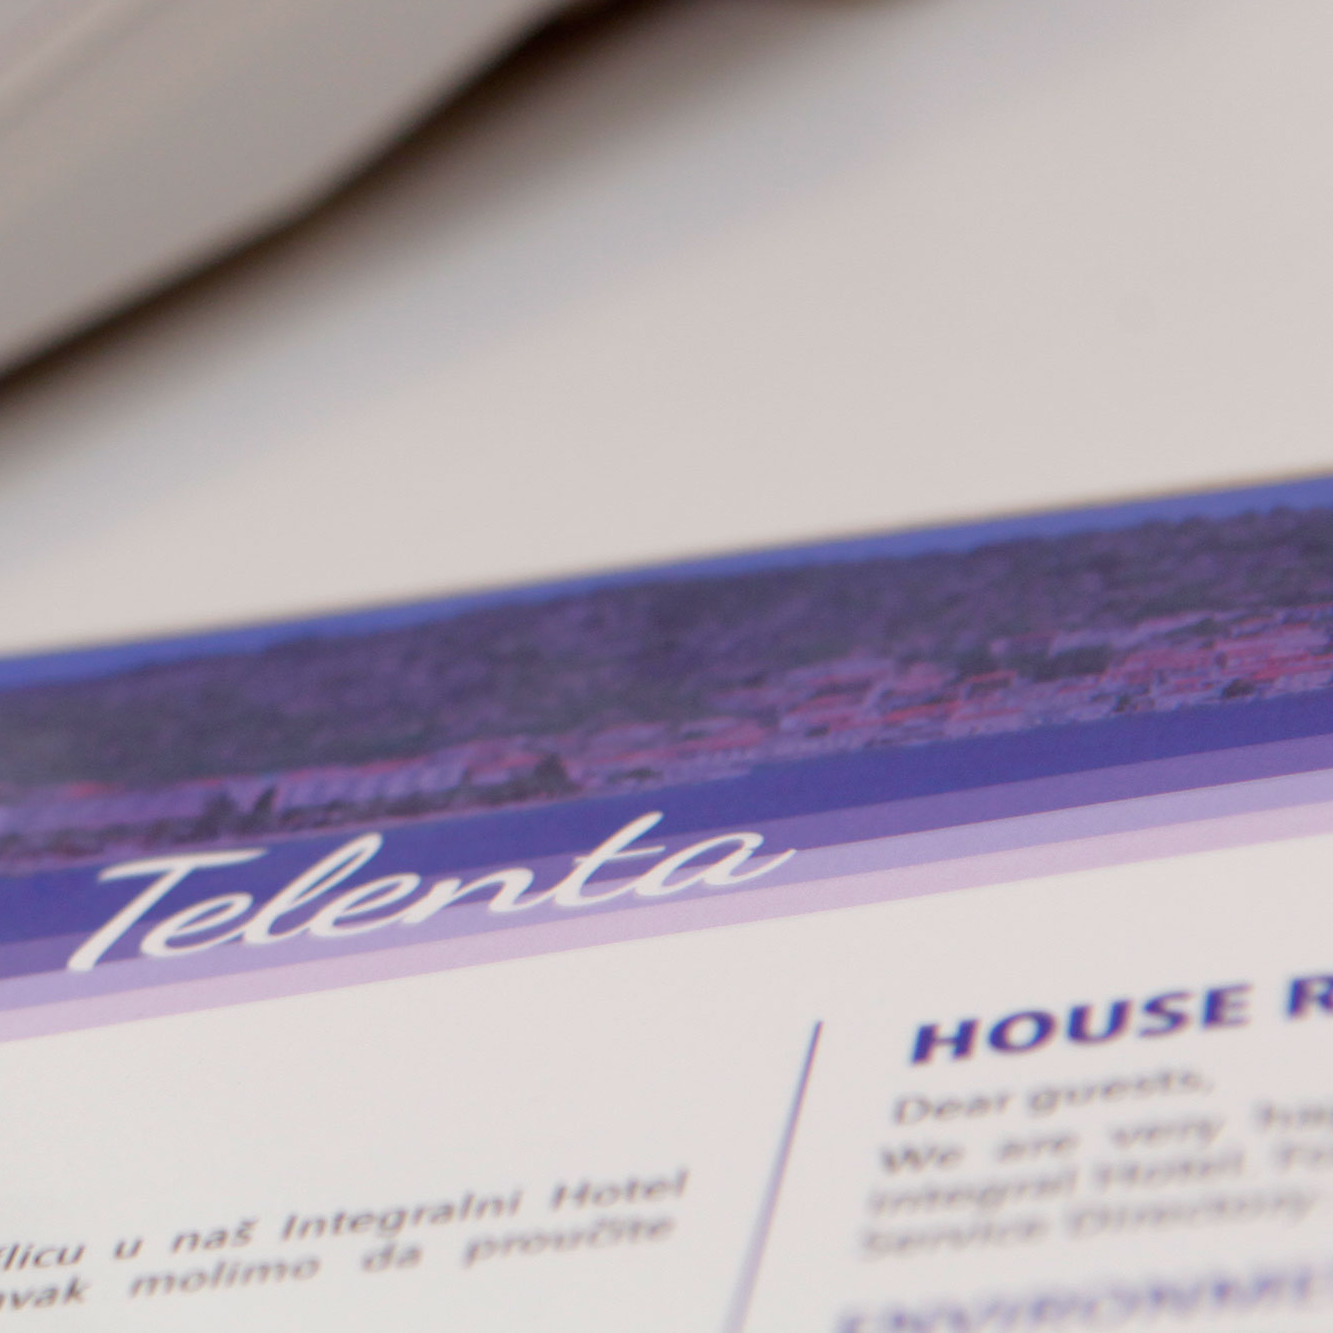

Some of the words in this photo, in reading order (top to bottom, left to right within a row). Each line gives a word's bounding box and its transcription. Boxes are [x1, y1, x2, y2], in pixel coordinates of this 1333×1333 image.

[66, 809, 800, 973] Telenta
[908, 981, 1256, 1068] HOUSE
[890, 1088, 1018, 1128] Dear
[879, 1143, 966, 1175] We
[993, 1131, 1081, 1163] are
[113, 1235, 144, 1262] u
[169, 1216, 261, 1258] naš
[278, 1187, 522, 1247] Integralni
[547, 1167, 691, 1214] Hotel
[128, 1252, 322, 1303] molimo
[361, 1239, 425, 1275] da
[461, 1212, 678, 1269] proučite
